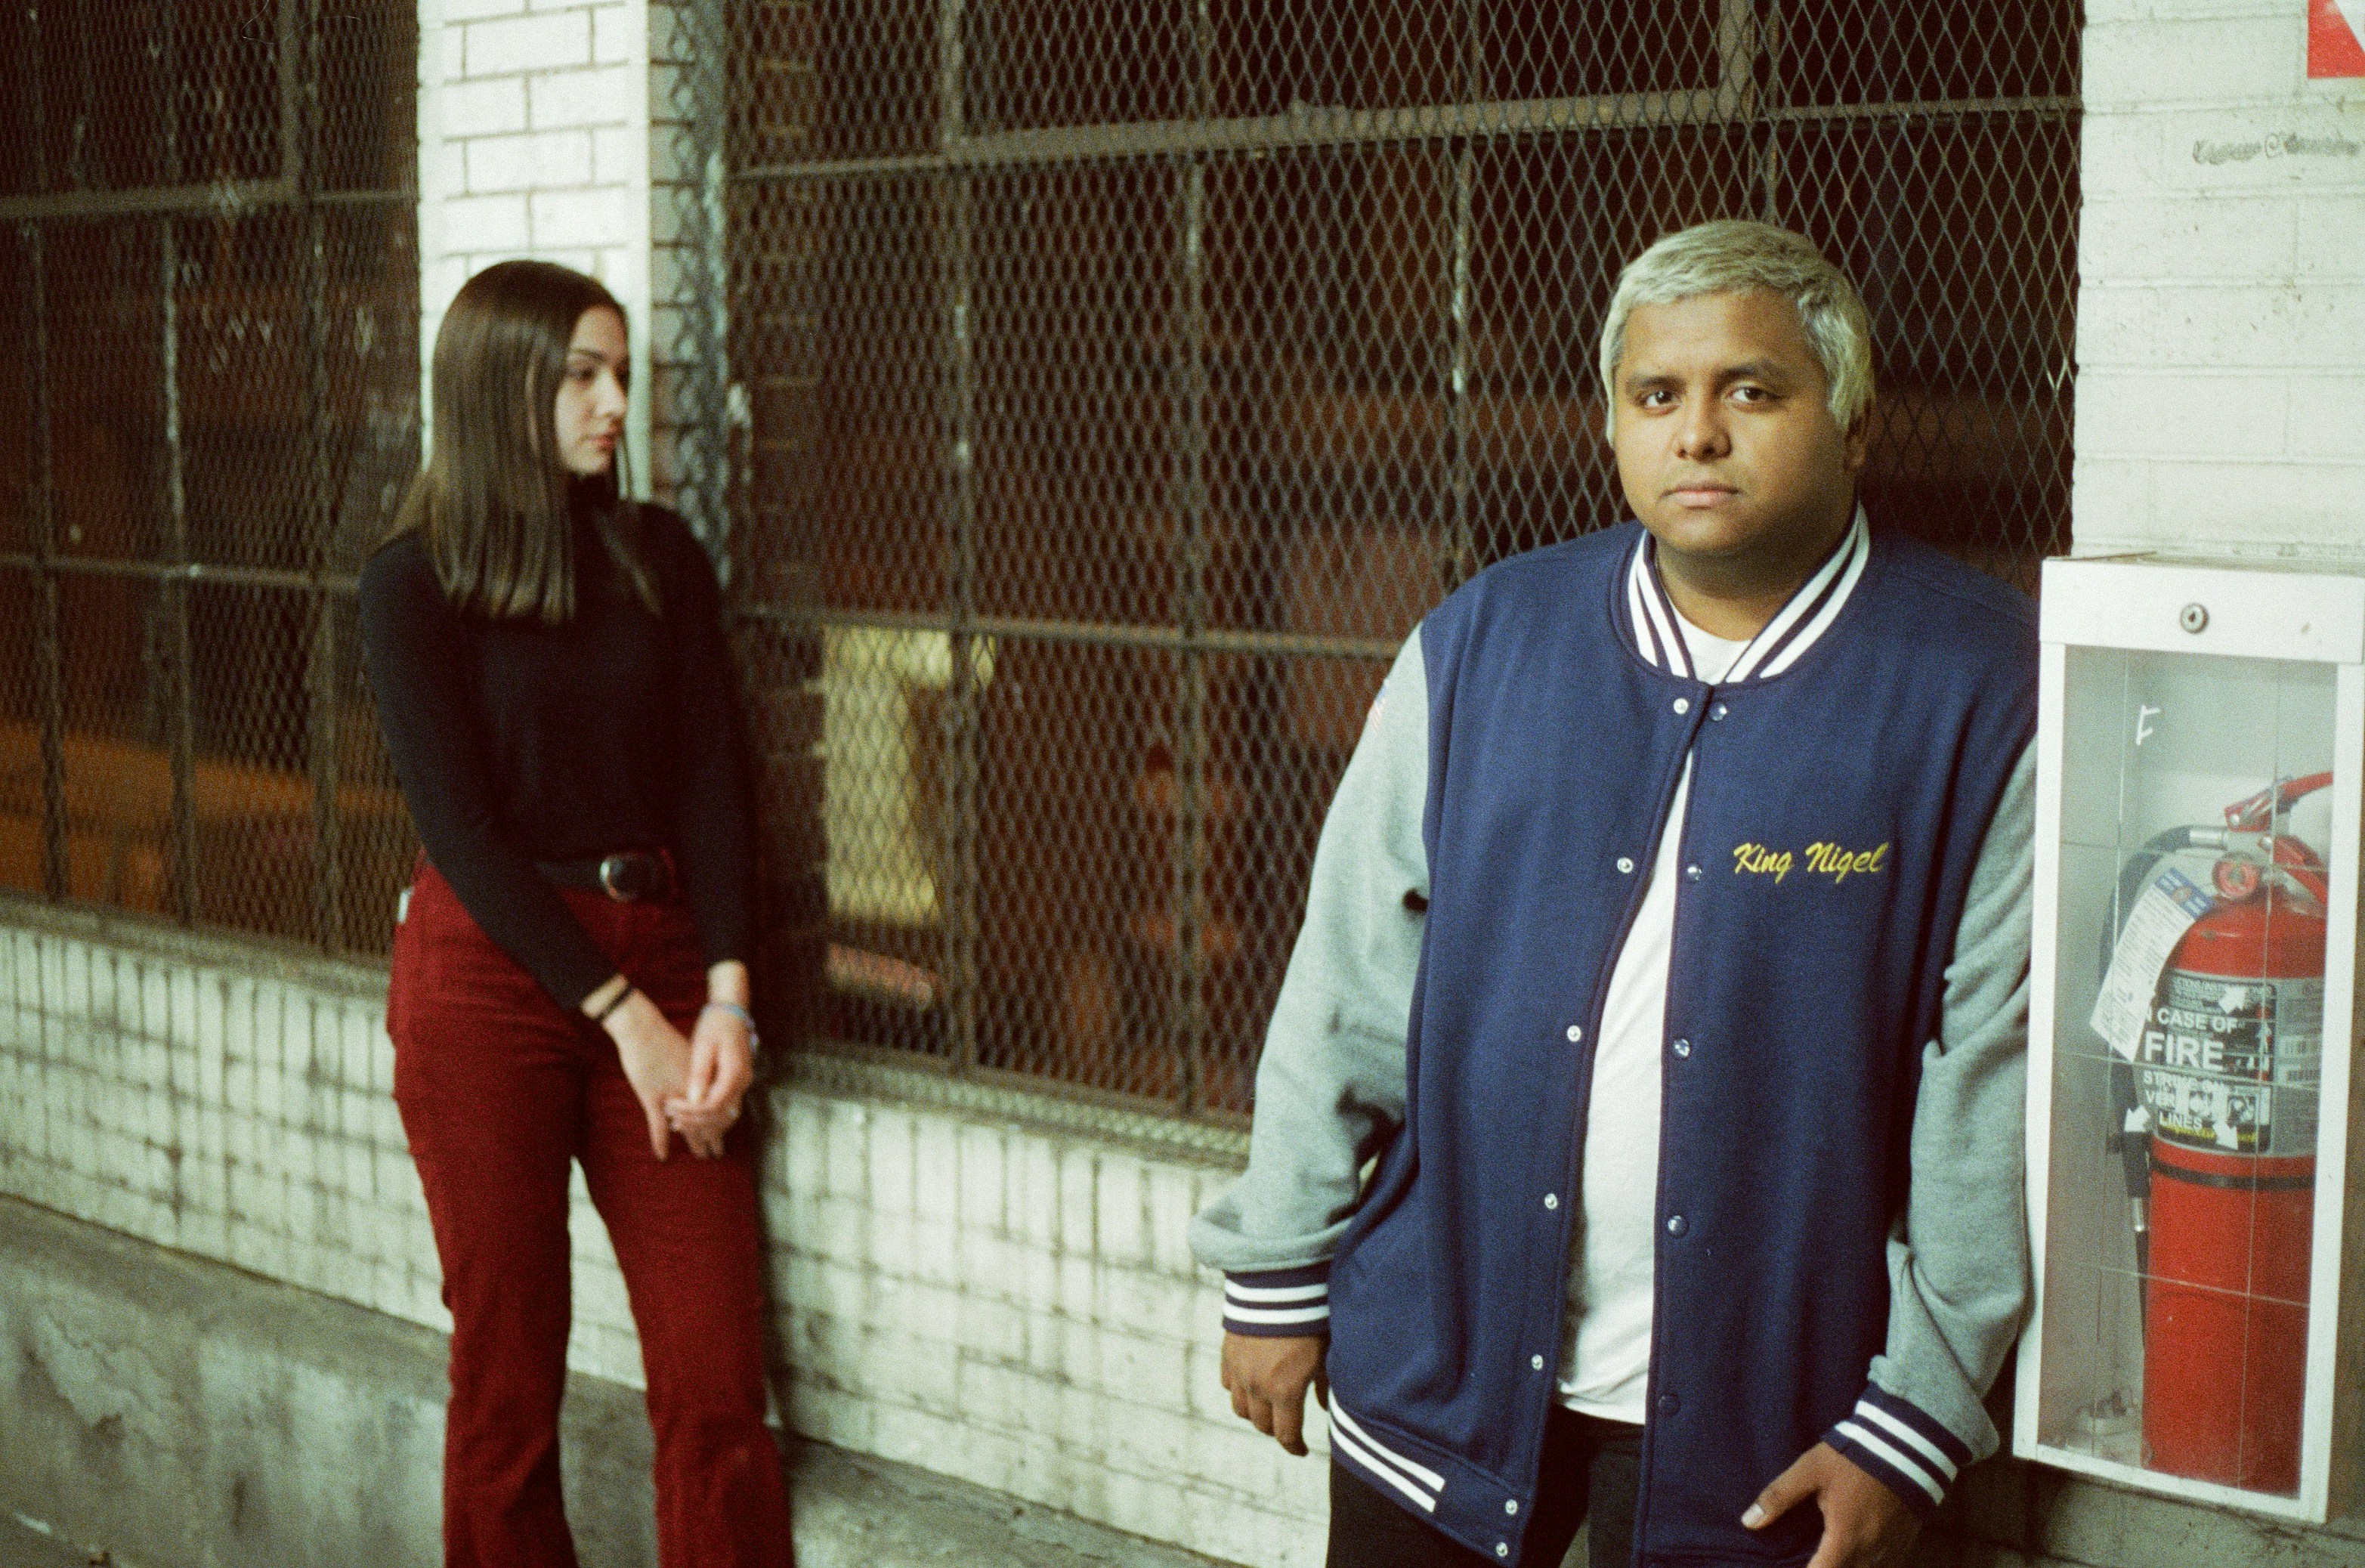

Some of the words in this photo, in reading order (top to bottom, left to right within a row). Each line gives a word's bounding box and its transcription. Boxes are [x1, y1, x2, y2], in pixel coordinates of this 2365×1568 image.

[1733, 842, 1792, 884] King
[1805, 841, 1888, 884] Nigel
[2157, 1007, 2207, 1031] CASE
[2212, 1016, 2238, 1034] OF
[2144, 1030, 2224, 1071] FIRE
[2159, 1112, 2203, 1130] LINES
